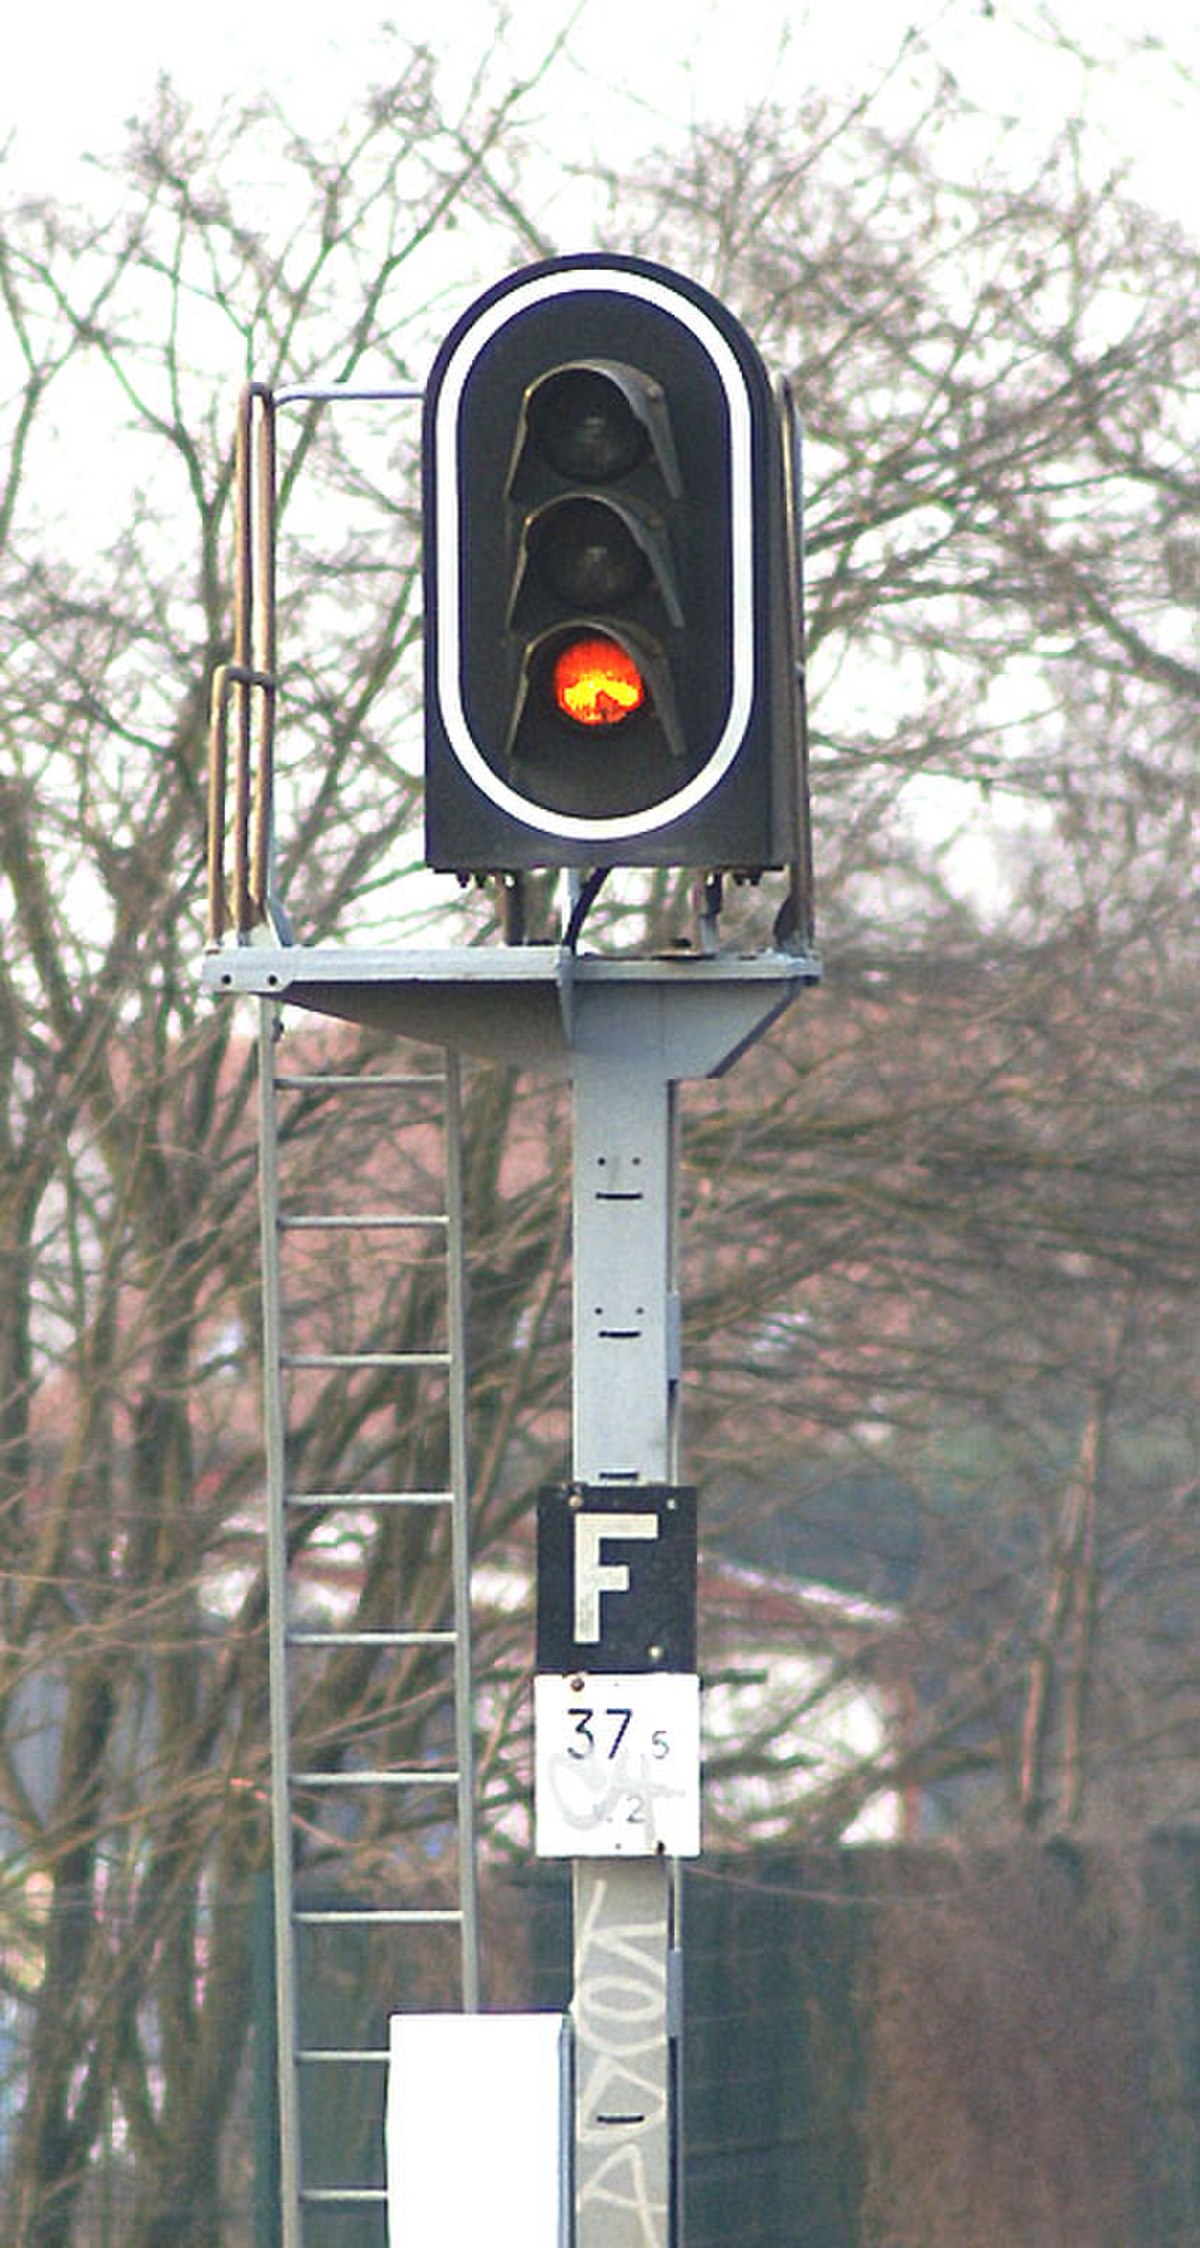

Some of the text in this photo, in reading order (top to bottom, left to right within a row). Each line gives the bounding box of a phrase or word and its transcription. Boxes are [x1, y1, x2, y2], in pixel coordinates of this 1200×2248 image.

[573, 1513, 658, 1645] F
[567, 1707, 671, 1761] 37 5
